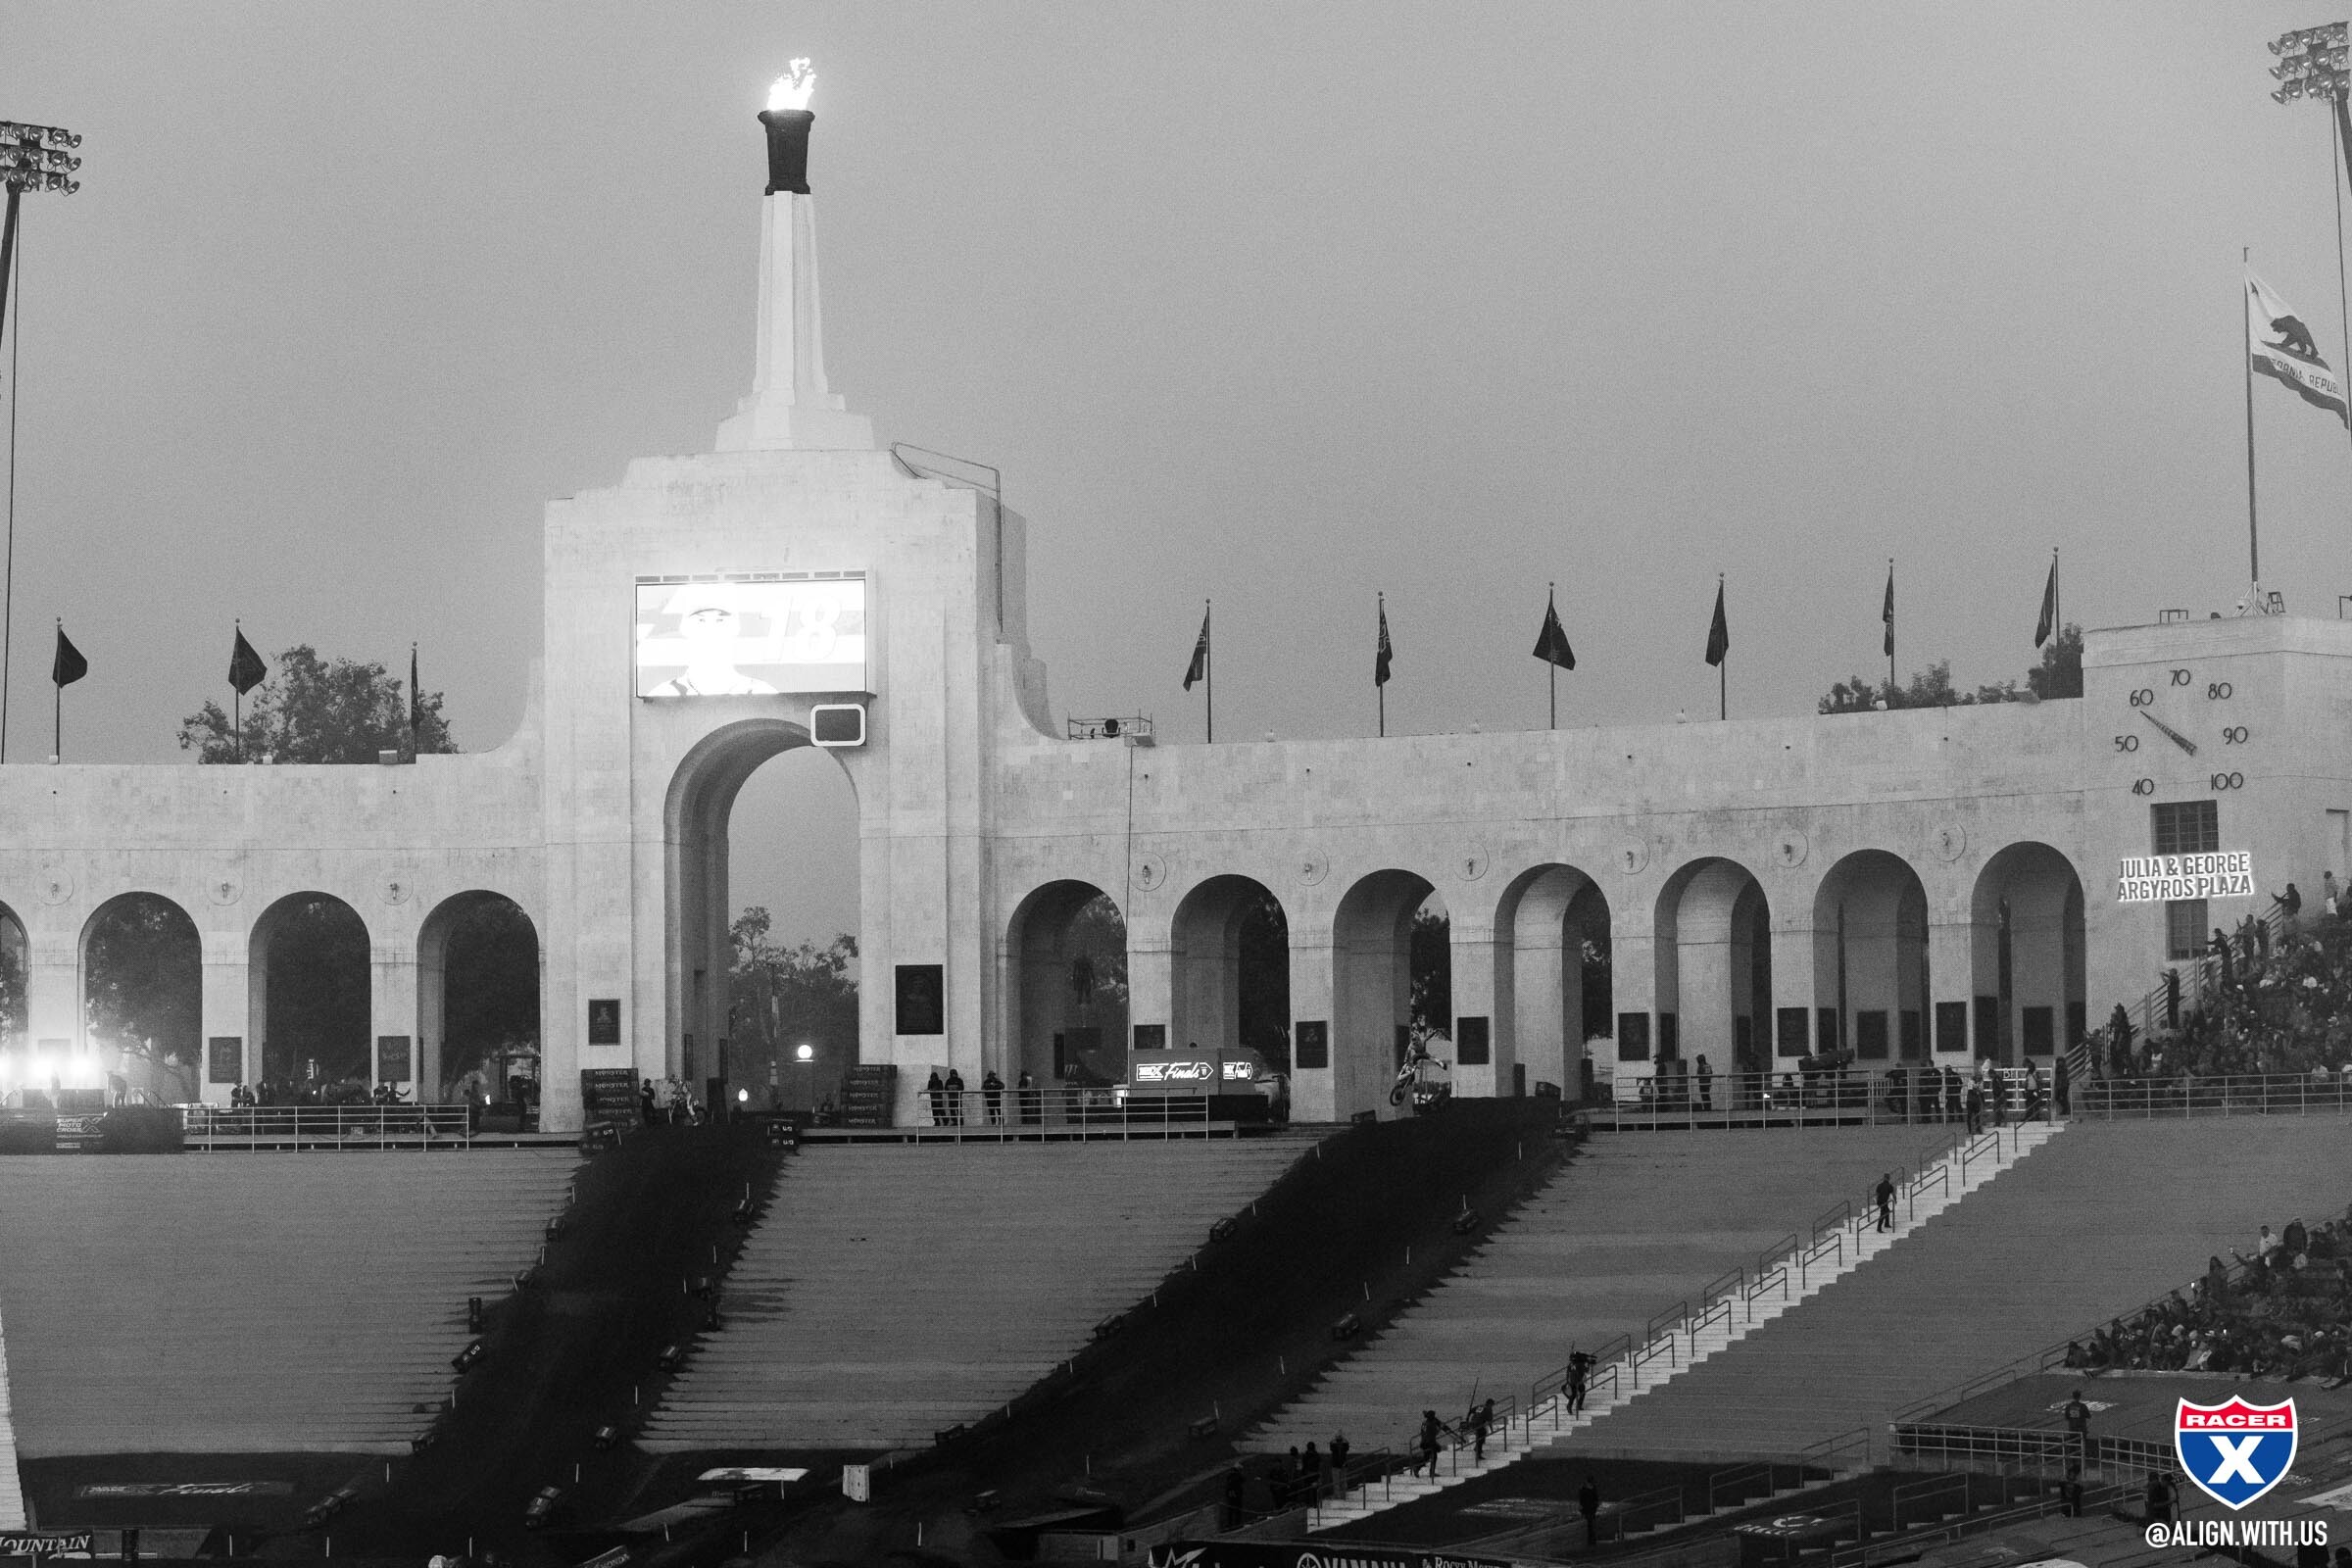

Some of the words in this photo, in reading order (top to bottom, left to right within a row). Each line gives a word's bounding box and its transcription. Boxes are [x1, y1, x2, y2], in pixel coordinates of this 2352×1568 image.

[759, 595, 842, 662] 18
[2169, 668, 2191, 686] 70
[2129, 688, 2154, 707] 60
[2208, 682, 2232, 700] 80
[2114, 734, 2139, 753] 50
[2223, 725, 2249, 745] 90
[2132, 778, 2154, 796] 40
[2211, 771, 2244, 791] 100
[2118, 858, 2162, 879] JULIA
[2166, 857, 2180, 876] &
[2182, 854, 2250, 875] GEORGE
[2116, 878, 2194, 901] ARGYROS
[2197, 874, 2253, 897] PLAZA
[1164, 1061, 1200, 1081] Finals
